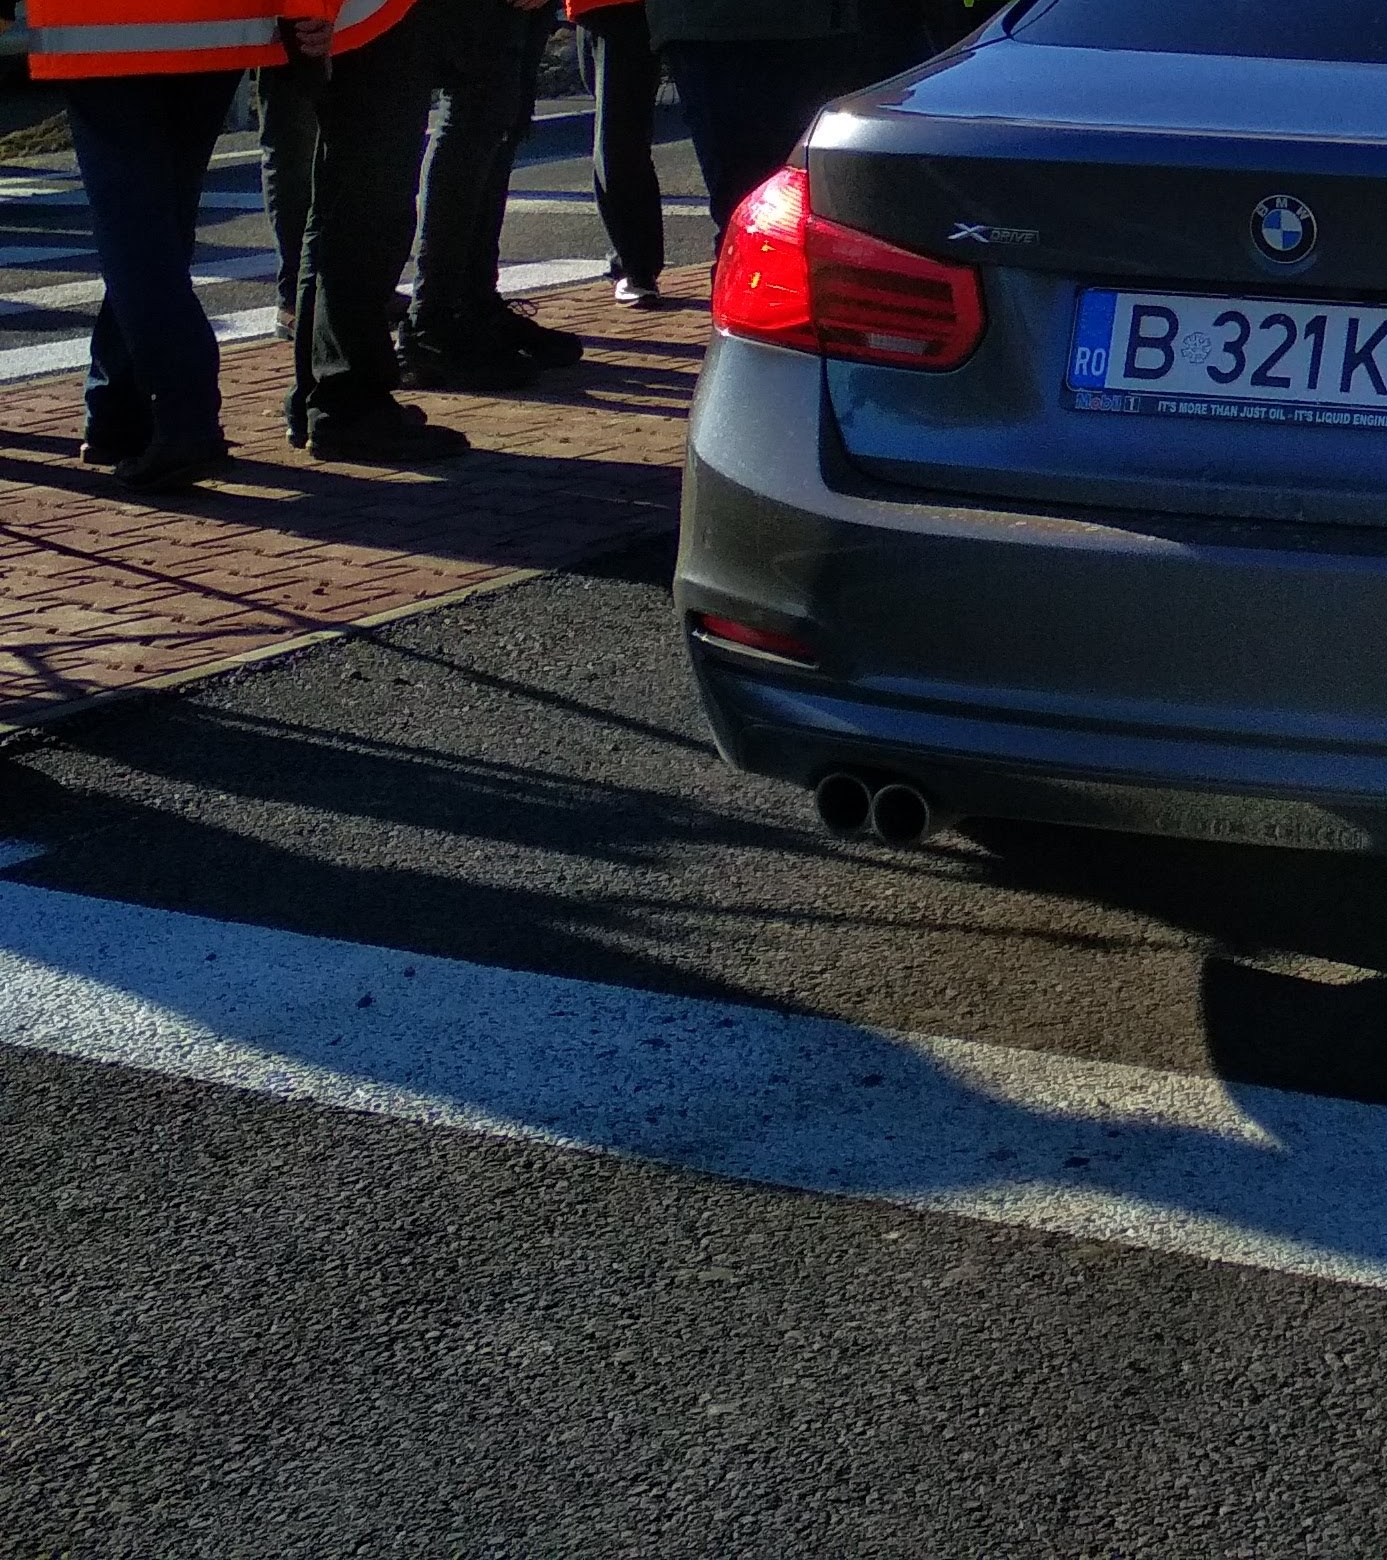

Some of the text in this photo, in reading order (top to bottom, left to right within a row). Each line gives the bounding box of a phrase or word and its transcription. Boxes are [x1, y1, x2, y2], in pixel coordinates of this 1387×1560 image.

[1256, 197, 1311, 220] BMW
[1123, 304, 1179, 380] B
[1074, 346, 1107, 376] RO
[1158, 400, 1177, 413] IT'S
[1179, 401, 1207, 415] MORE
[1210, 404, 1238, 417] THAN
[1240, 406, 1267, 419] JUST
[1269, 408, 1286, 420] OIL
[1294, 409, 1313, 422] IT'S
[1315, 410, 1351, 424] LIQUID
